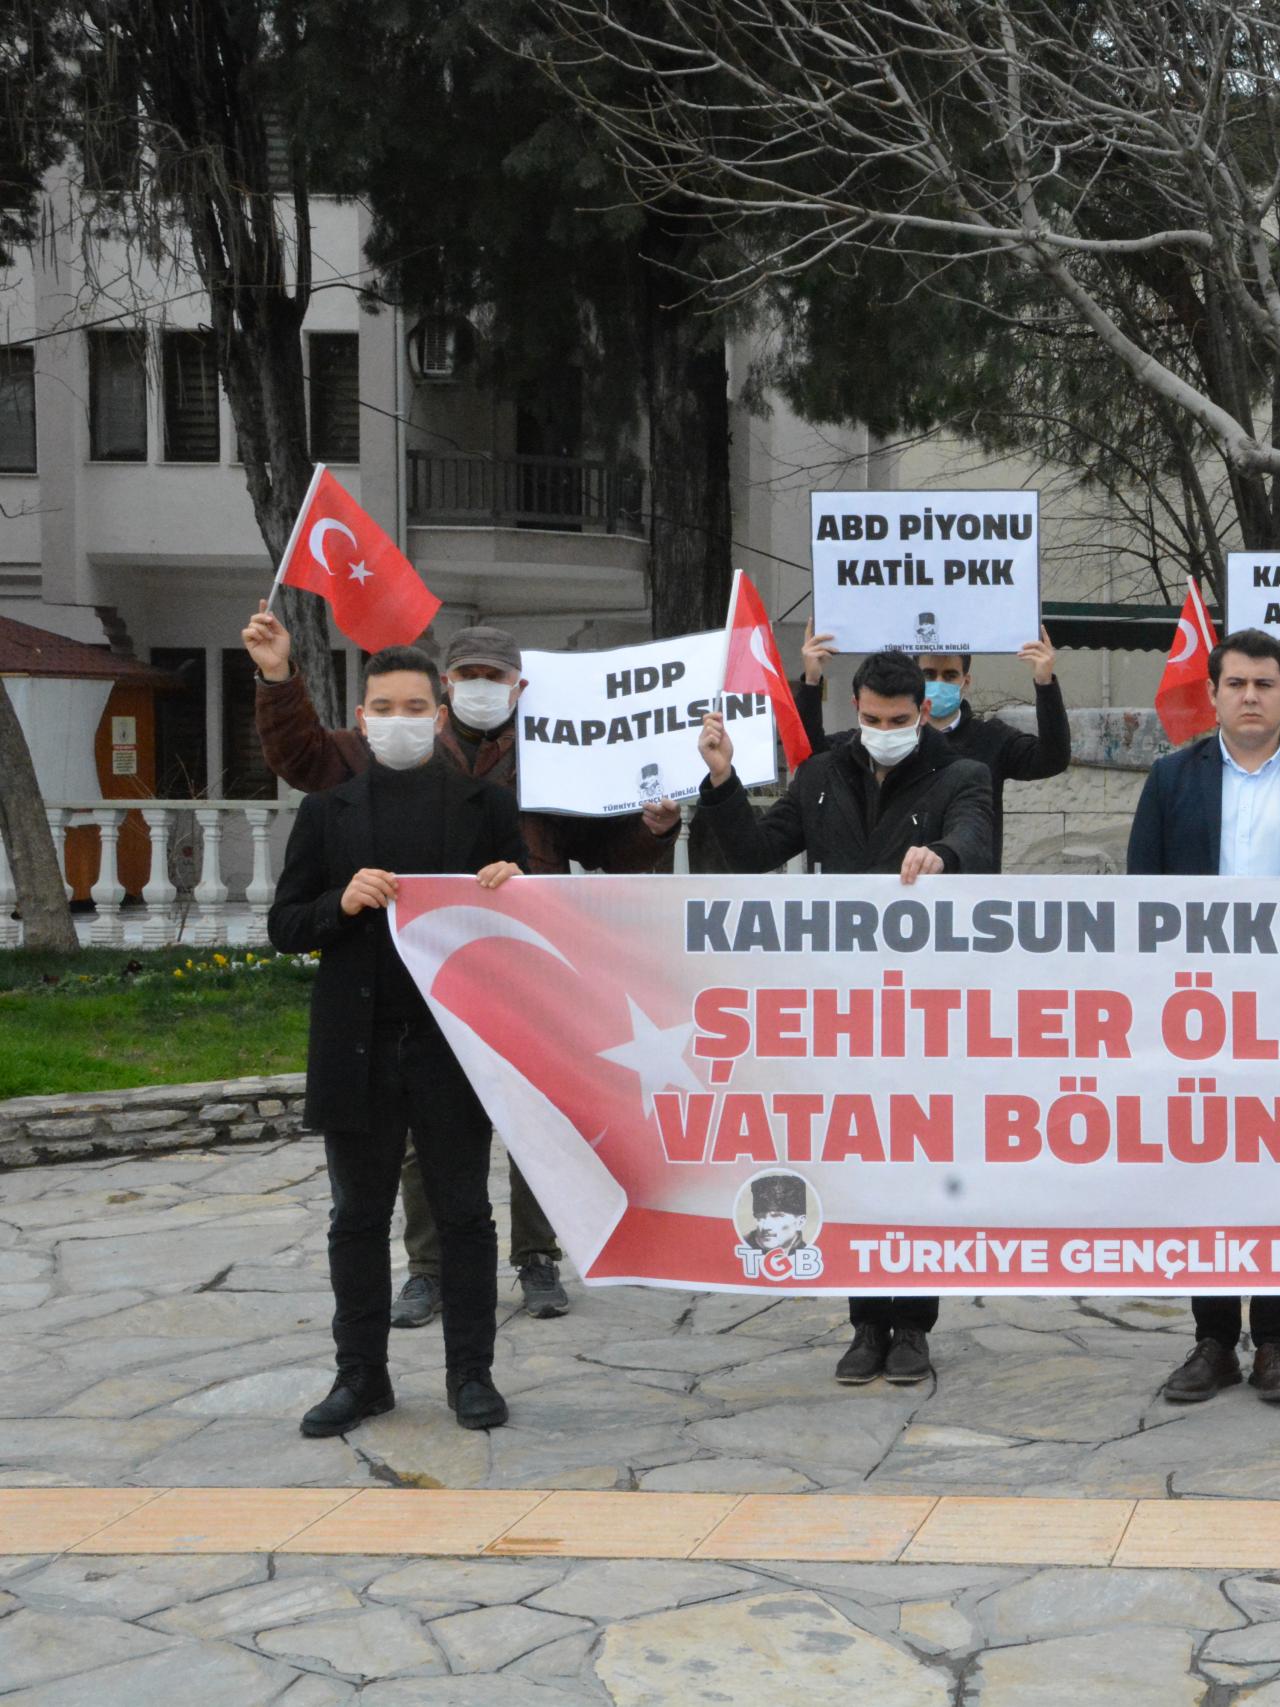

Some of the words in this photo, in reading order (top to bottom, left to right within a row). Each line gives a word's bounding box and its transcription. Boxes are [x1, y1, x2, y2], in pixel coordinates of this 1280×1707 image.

[816, 514, 889, 541] ABD
[899, 507, 1033, 541] PİYONU
[837, 552, 934, 586] KATİL
[944, 559, 1015, 586] PKK
[606, 660, 686, 700] HDP
[685, 899, 1116, 954] KAHROLSUN
[1138, 901, 1279, 955] PKK
[693, 970, 1133, 1084] ŞEHİTLER
[652, 1093, 955, 1164] VATAN
[736, 1246, 823, 1279] TGB
[849, 1231, 1049, 1273] TÜRKİYE
[1059, 1231, 1261, 1280] GENÇLİK
